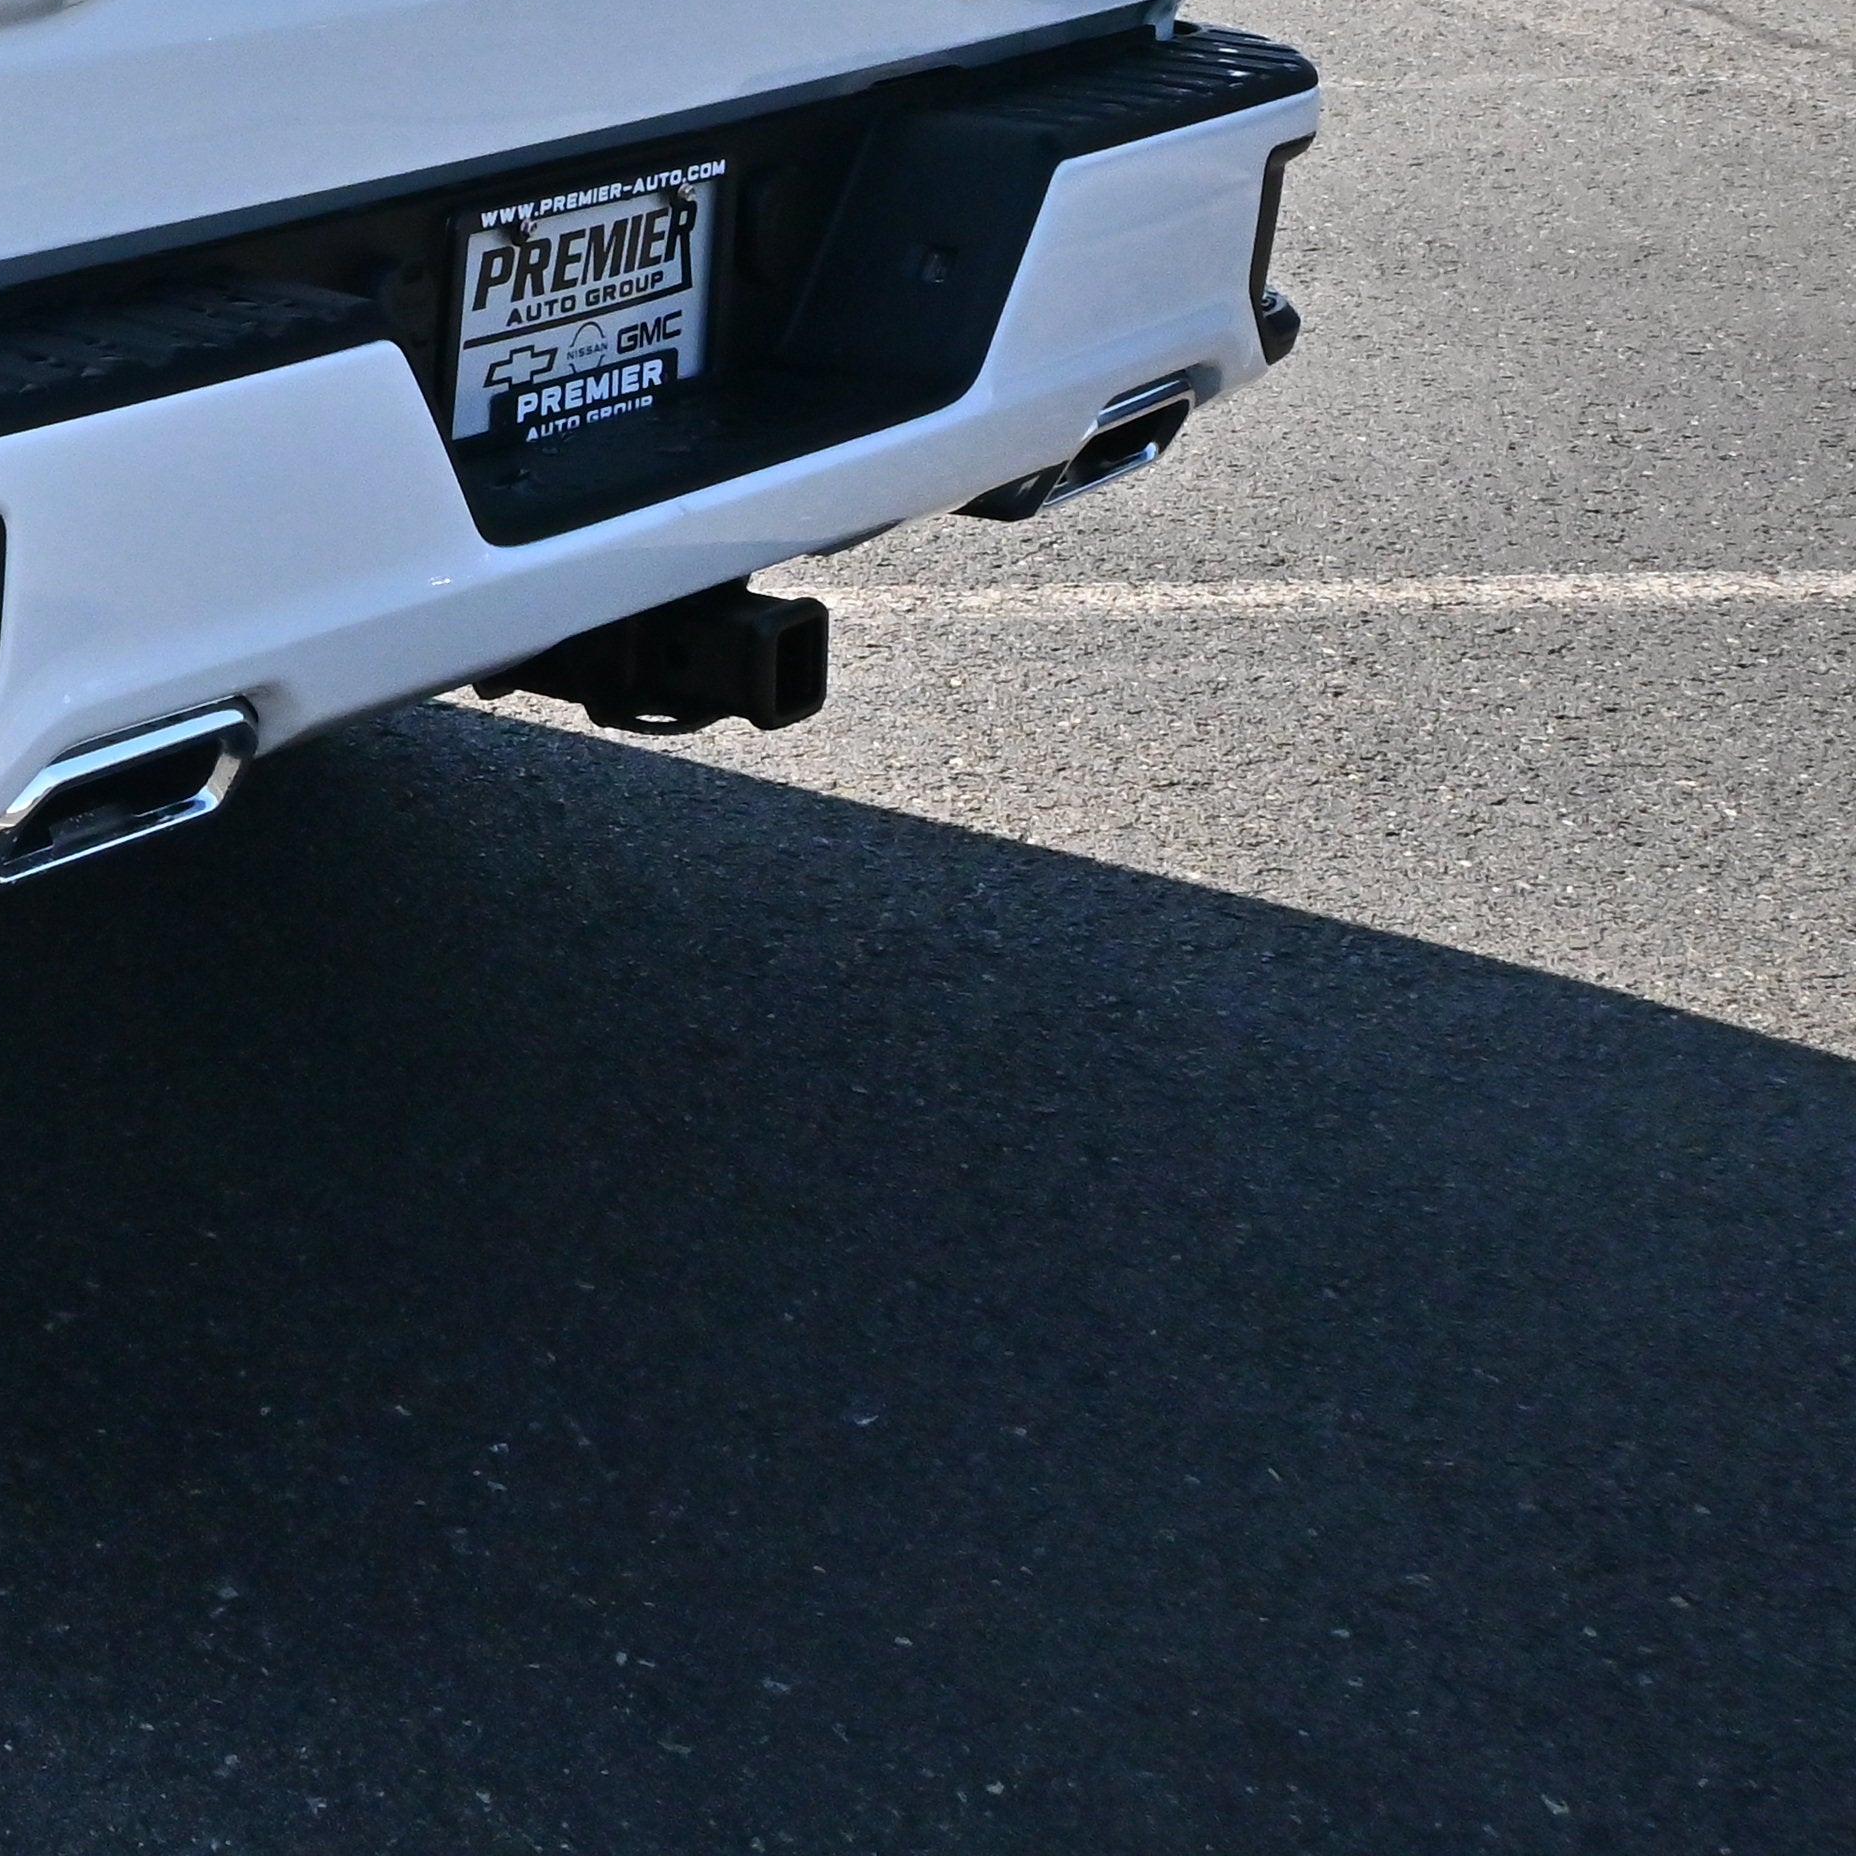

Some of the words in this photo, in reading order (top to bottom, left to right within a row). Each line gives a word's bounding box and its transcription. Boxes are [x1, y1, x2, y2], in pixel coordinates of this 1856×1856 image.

[480, 159, 727, 229] WWW.PREMIER-AUTO.COM
[471, 199, 698, 312] PREMIER
[505, 295, 576, 327] AUTO
[584, 270, 664, 307] GROUP
[566, 342, 609, 361] NISSAN
[616, 310, 683, 355] GMC
[516, 358, 664, 424] PREMIER
[525, 414, 581, 443] AUTO
